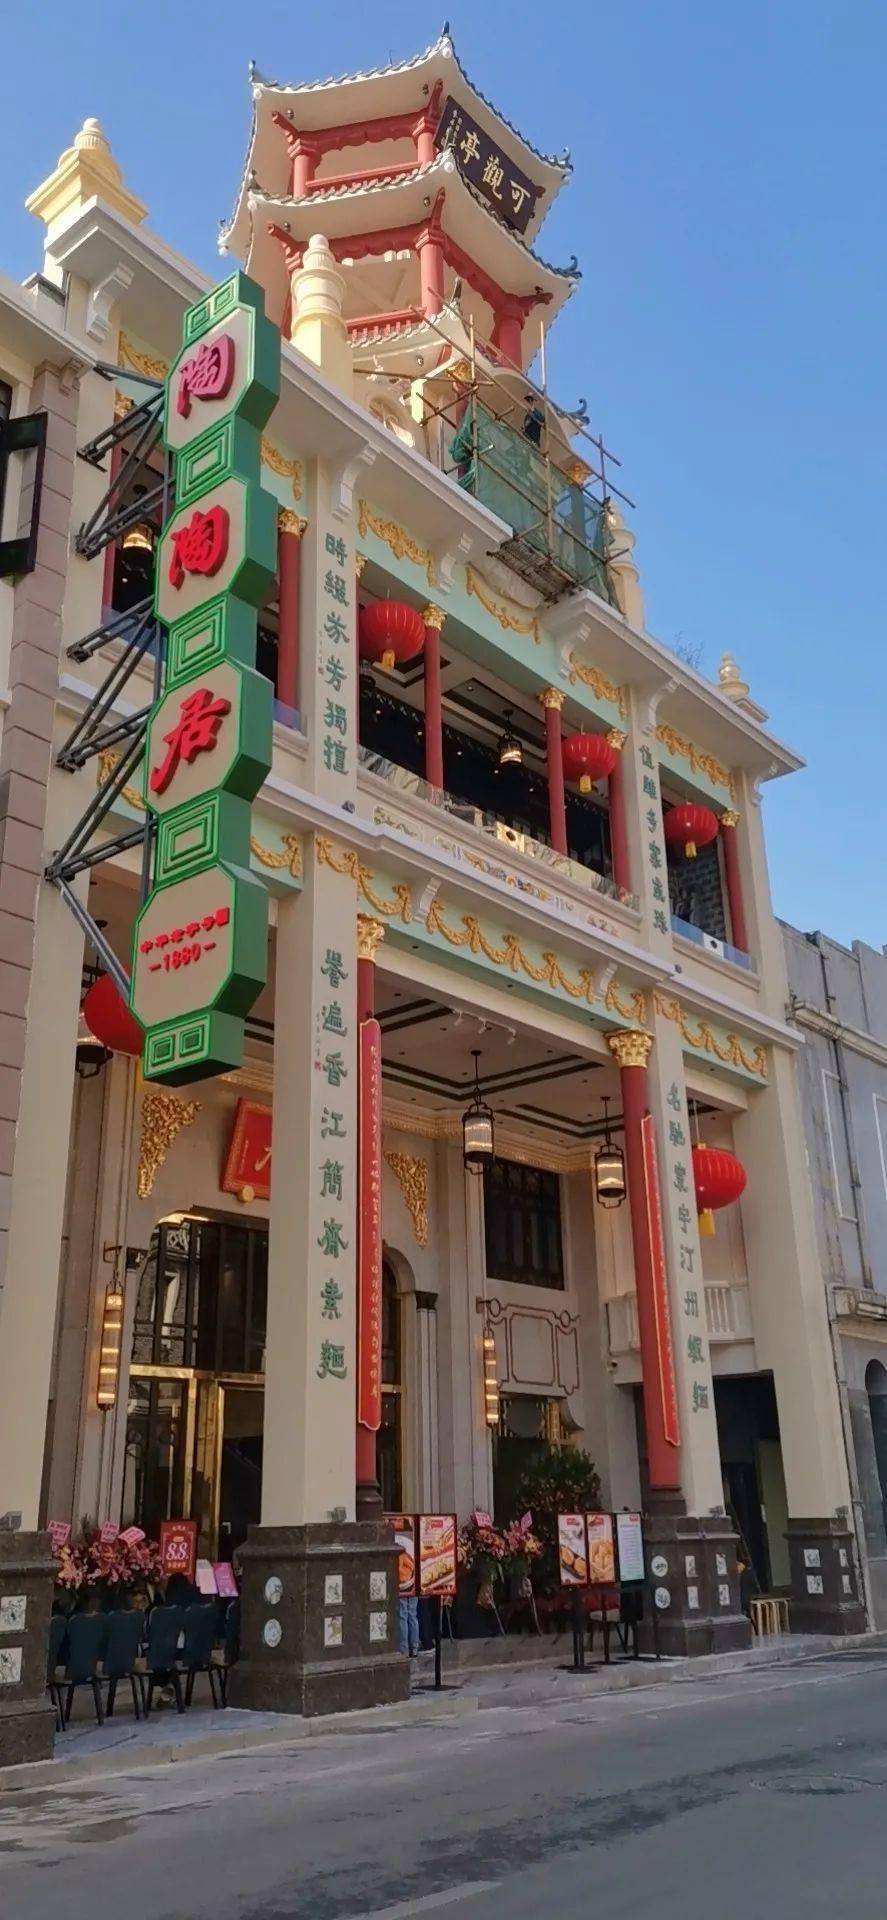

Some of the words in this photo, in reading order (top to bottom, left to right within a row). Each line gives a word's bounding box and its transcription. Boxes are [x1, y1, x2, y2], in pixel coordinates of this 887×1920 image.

[460, 131, 530, 213] 可觀亭
[150, 333, 236, 795] 陶陶居
